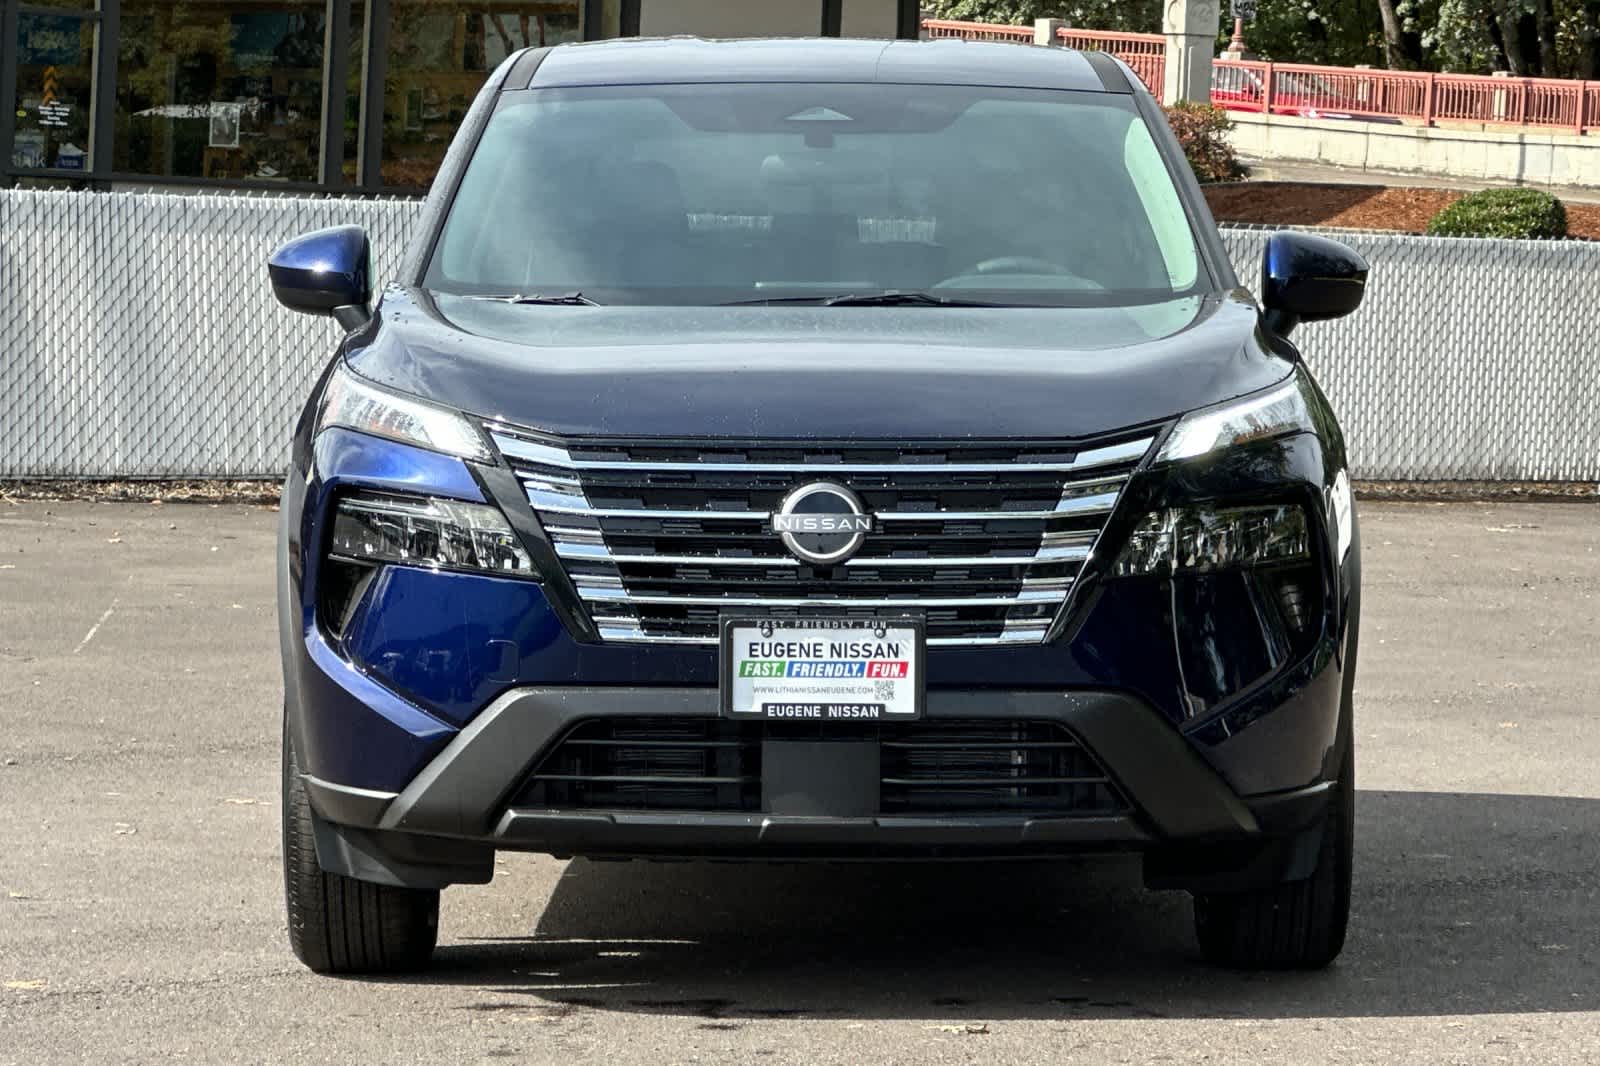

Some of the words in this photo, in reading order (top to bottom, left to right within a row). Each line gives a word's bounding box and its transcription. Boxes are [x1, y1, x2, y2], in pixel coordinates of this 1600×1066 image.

[778, 518, 871, 530] NISSAN
[749, 642, 823, 658] EUGENE
[830, 642, 899, 658] NISSAN
[744, 662, 782, 676] FAST.
[791, 662, 862, 677] FRIENDLY.
[871, 662, 904, 677] FUN.
[767, 705, 821, 717] EUGENE
[828, 705, 879, 718] NISSAN
